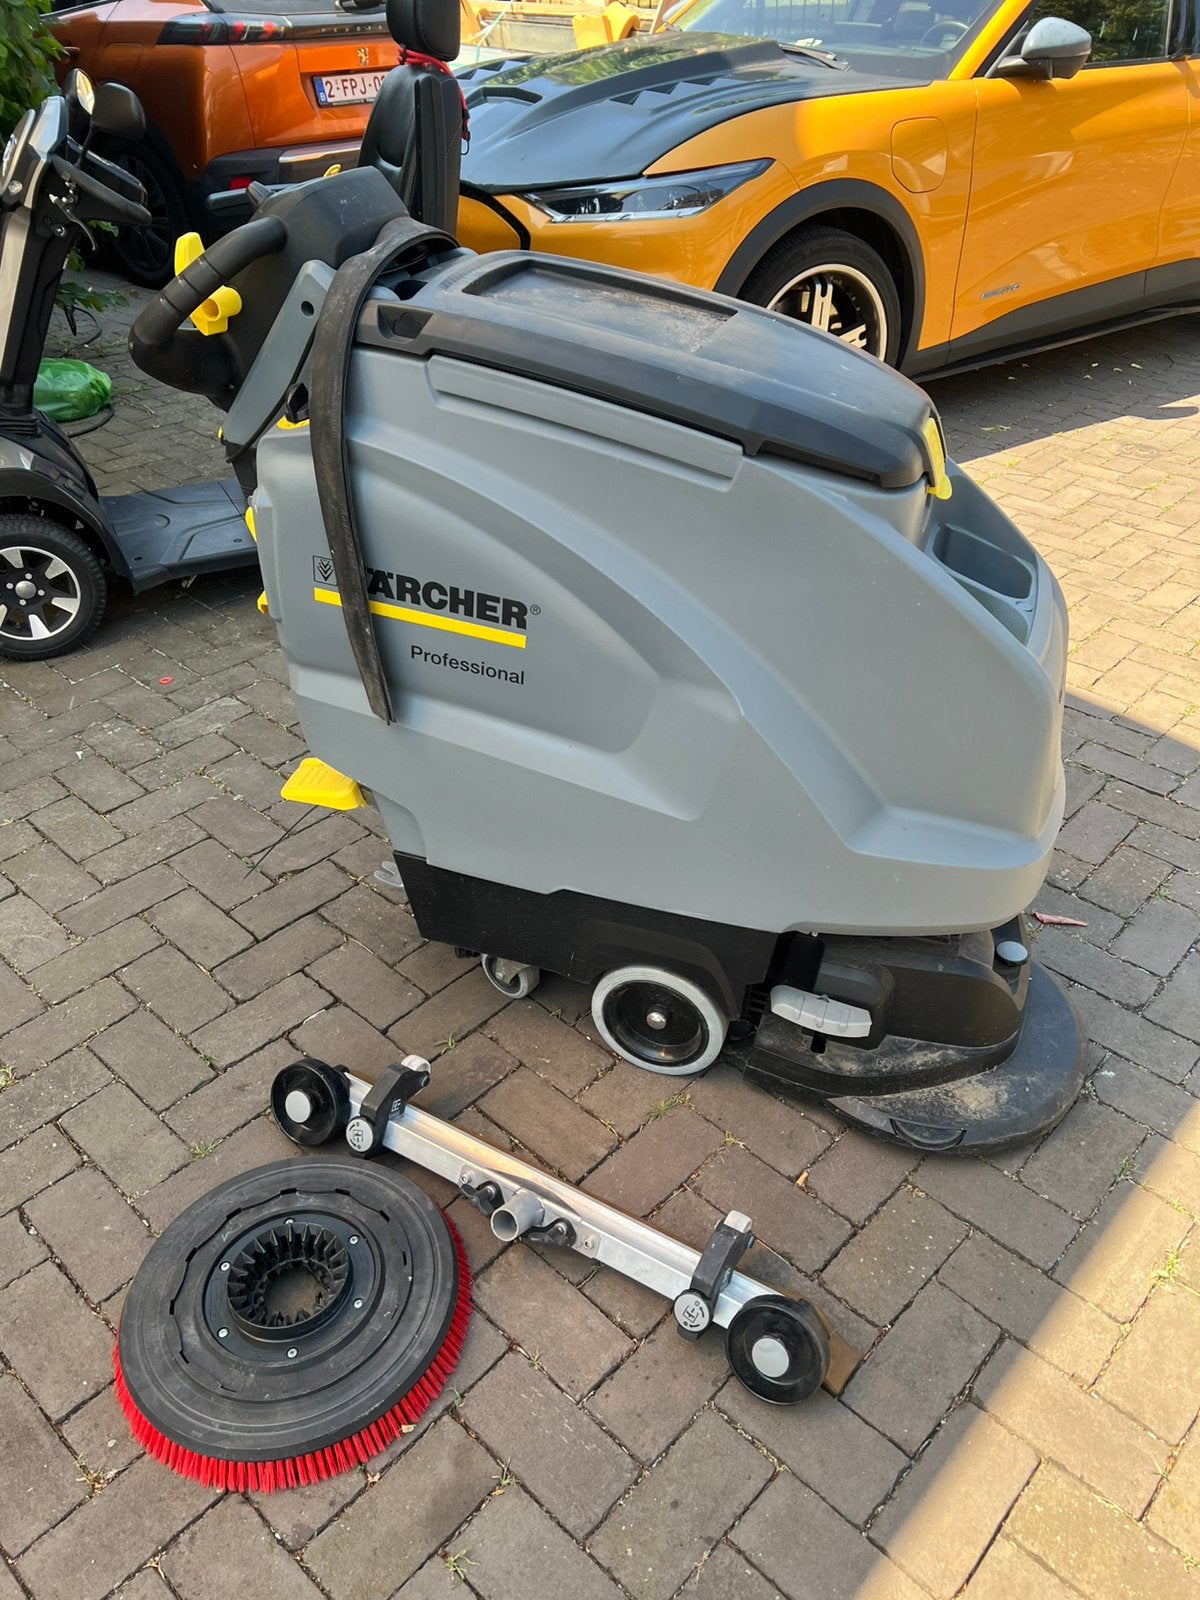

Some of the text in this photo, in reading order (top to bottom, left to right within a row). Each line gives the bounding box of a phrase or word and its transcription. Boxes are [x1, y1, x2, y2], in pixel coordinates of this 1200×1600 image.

[321, 25, 383, 33] PEUGEO
[364, 566, 541, 630] ÄRCHER®
[410, 645, 525, 685] Professional
